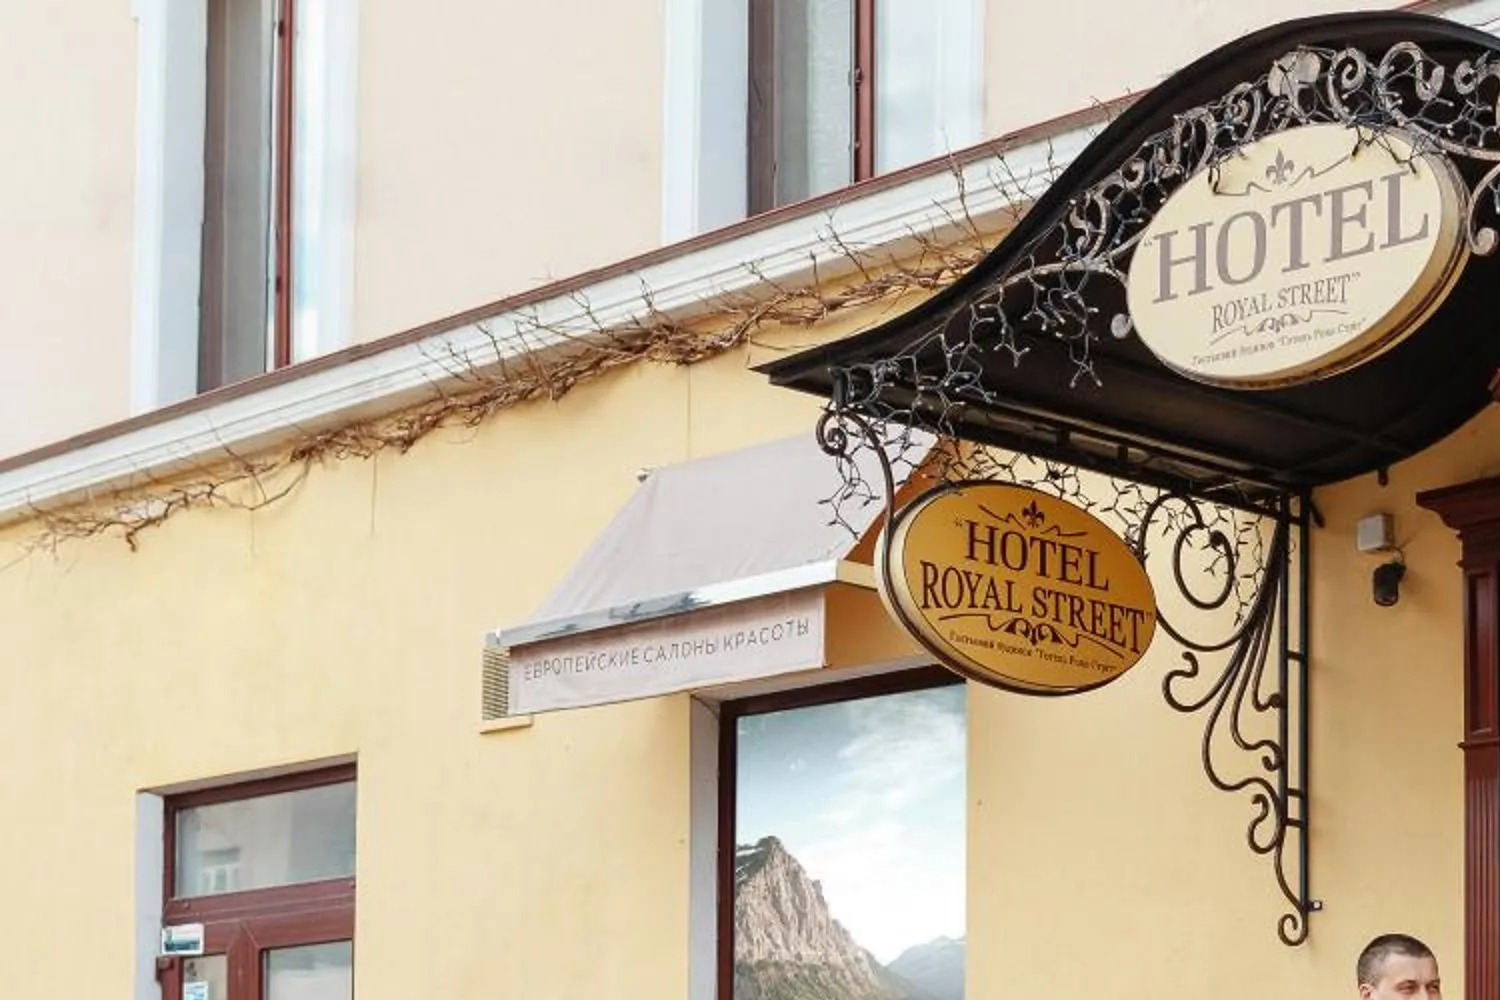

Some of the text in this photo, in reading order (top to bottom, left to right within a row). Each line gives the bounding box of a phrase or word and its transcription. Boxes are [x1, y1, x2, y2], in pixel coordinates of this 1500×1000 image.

[1211, 291, 1273, 334] ROYAL
[920, 560, 1023, 613] ROYAL
[523, 617, 810, 682] ЕВРОПЕЙСКИЕ САЛОНЫ КРАСОТЫ
